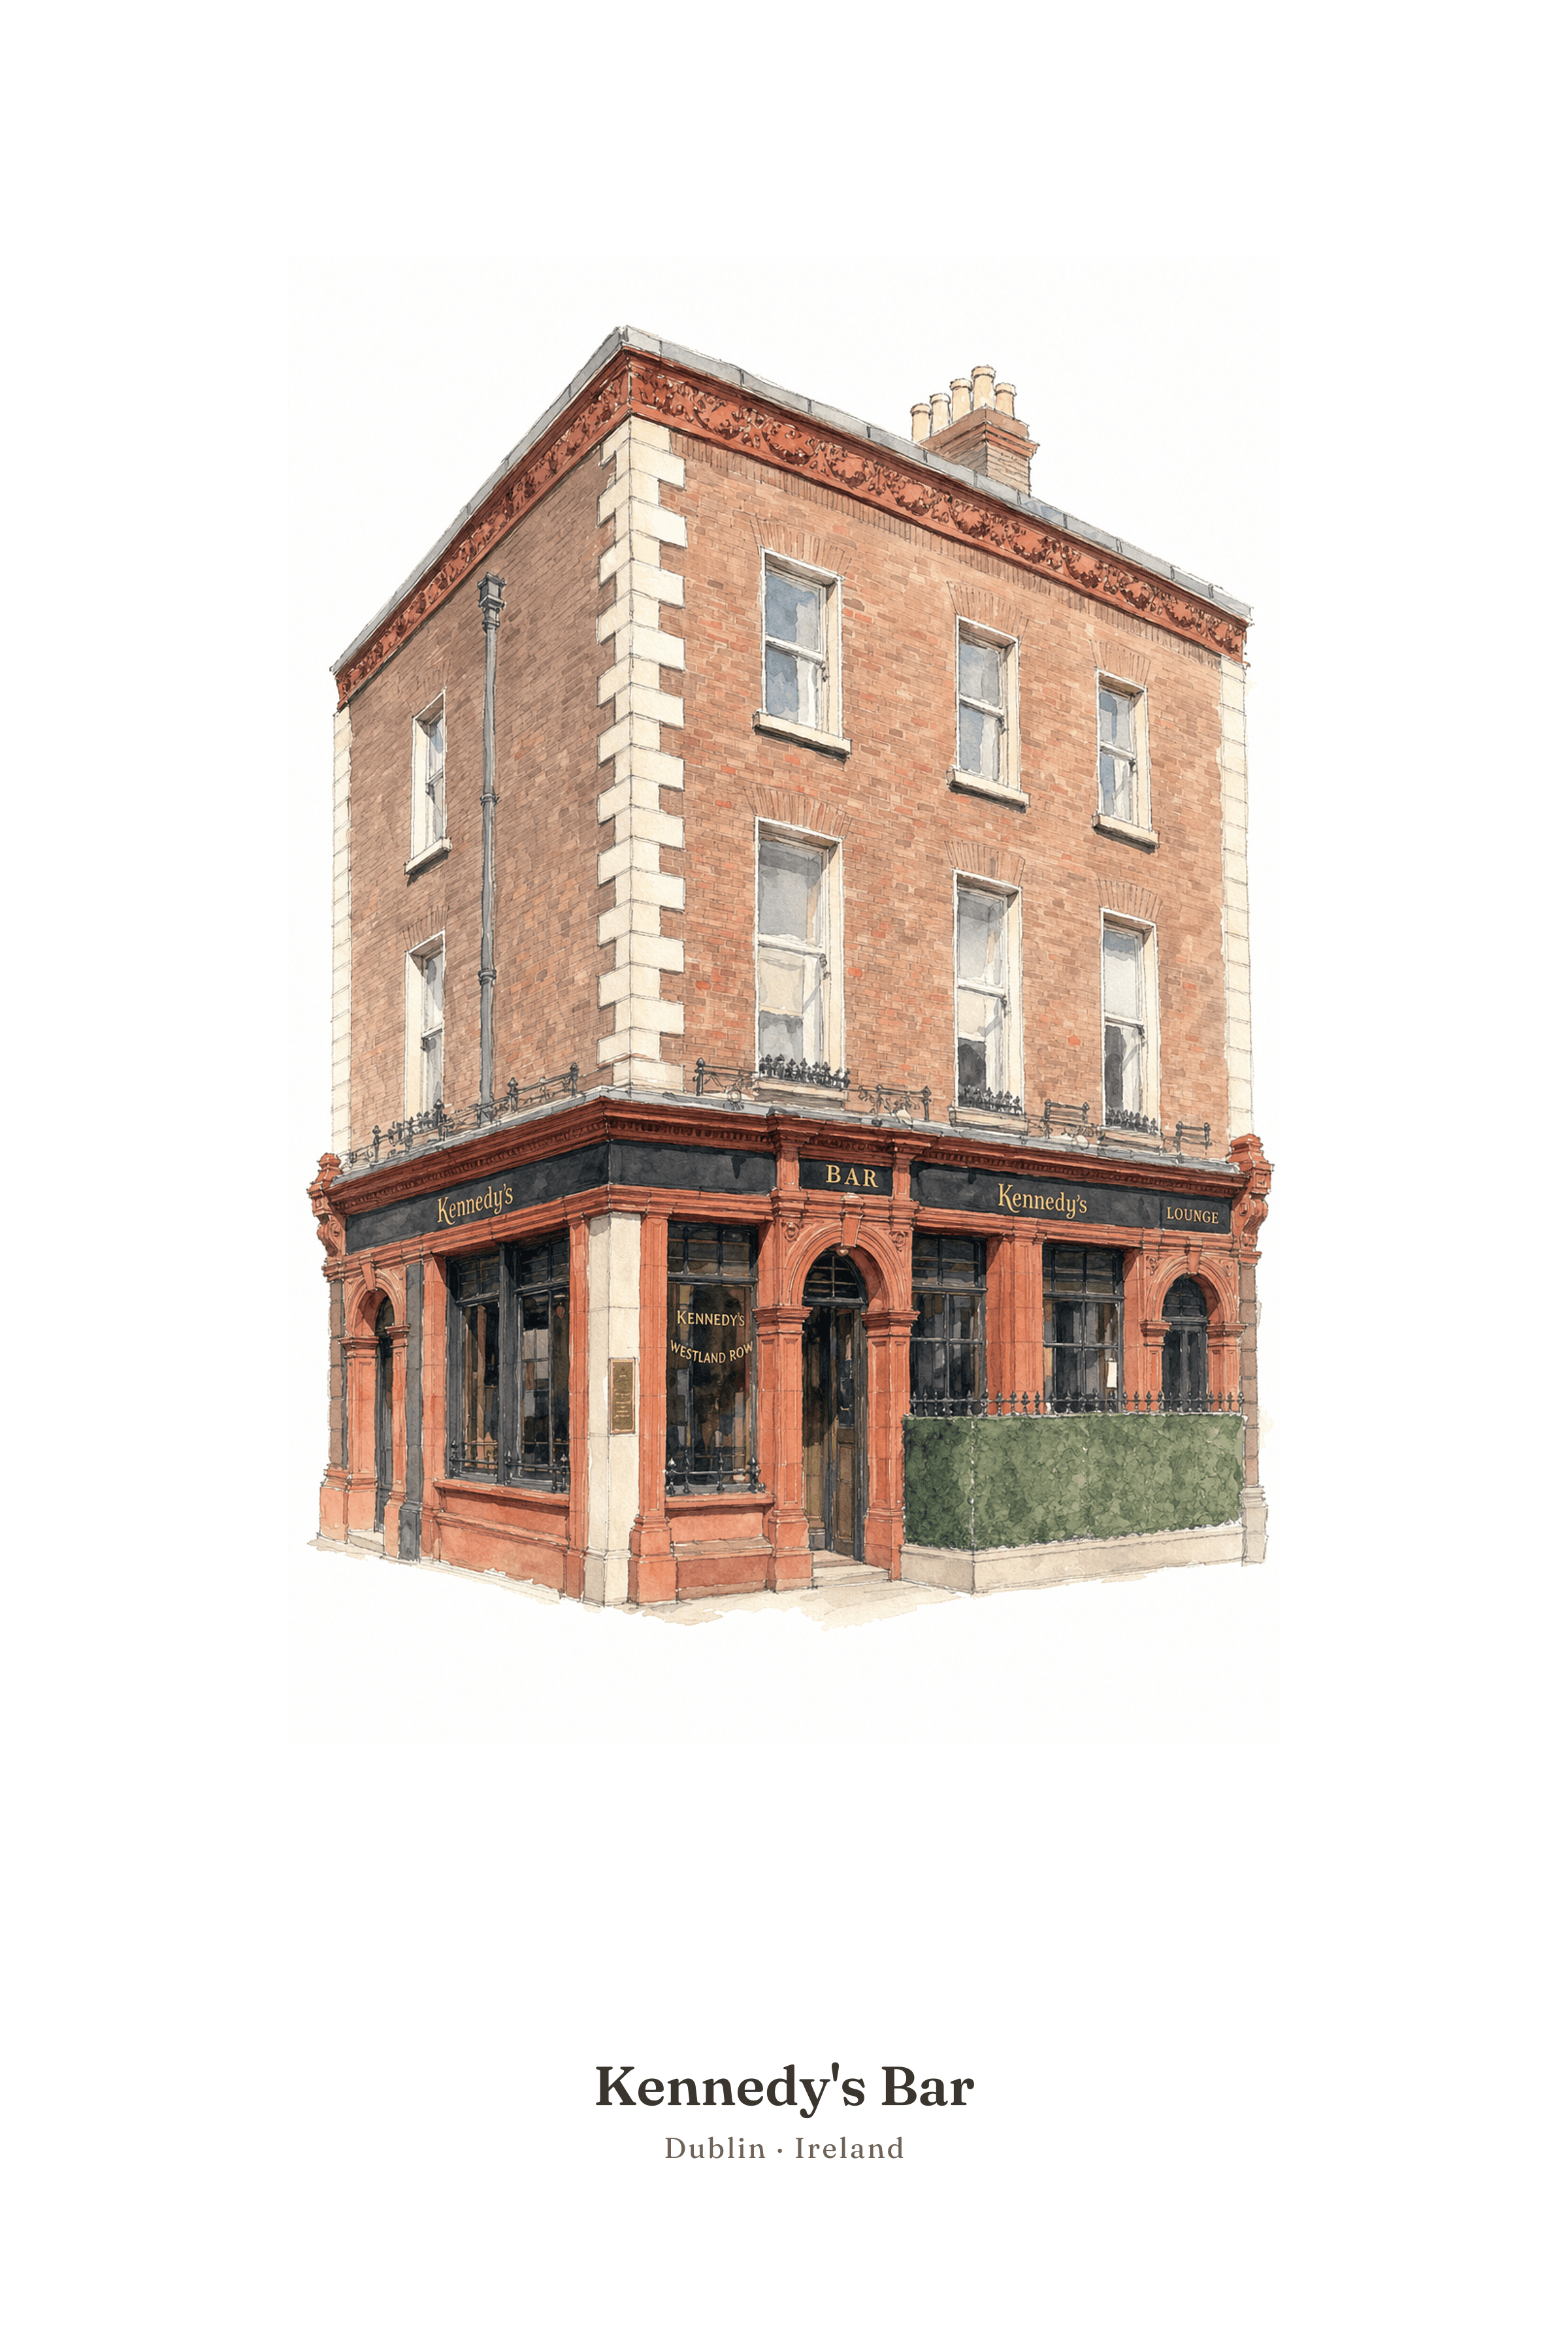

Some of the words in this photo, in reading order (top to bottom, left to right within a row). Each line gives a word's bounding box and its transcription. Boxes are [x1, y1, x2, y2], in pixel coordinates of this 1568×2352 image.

[825, 1164, 879, 1188] BAR
[436, 1183, 514, 1226] Kennedy's
[998, 1183, 1088, 1220] Kennedy's
[1167, 1207, 1219, 1224] LOUNGE
[677, 1310, 745, 1327] KENNEDY'S
[670, 1339, 726, 1364] WESTLAND
[729, 1341, 753, 1362] ROW
